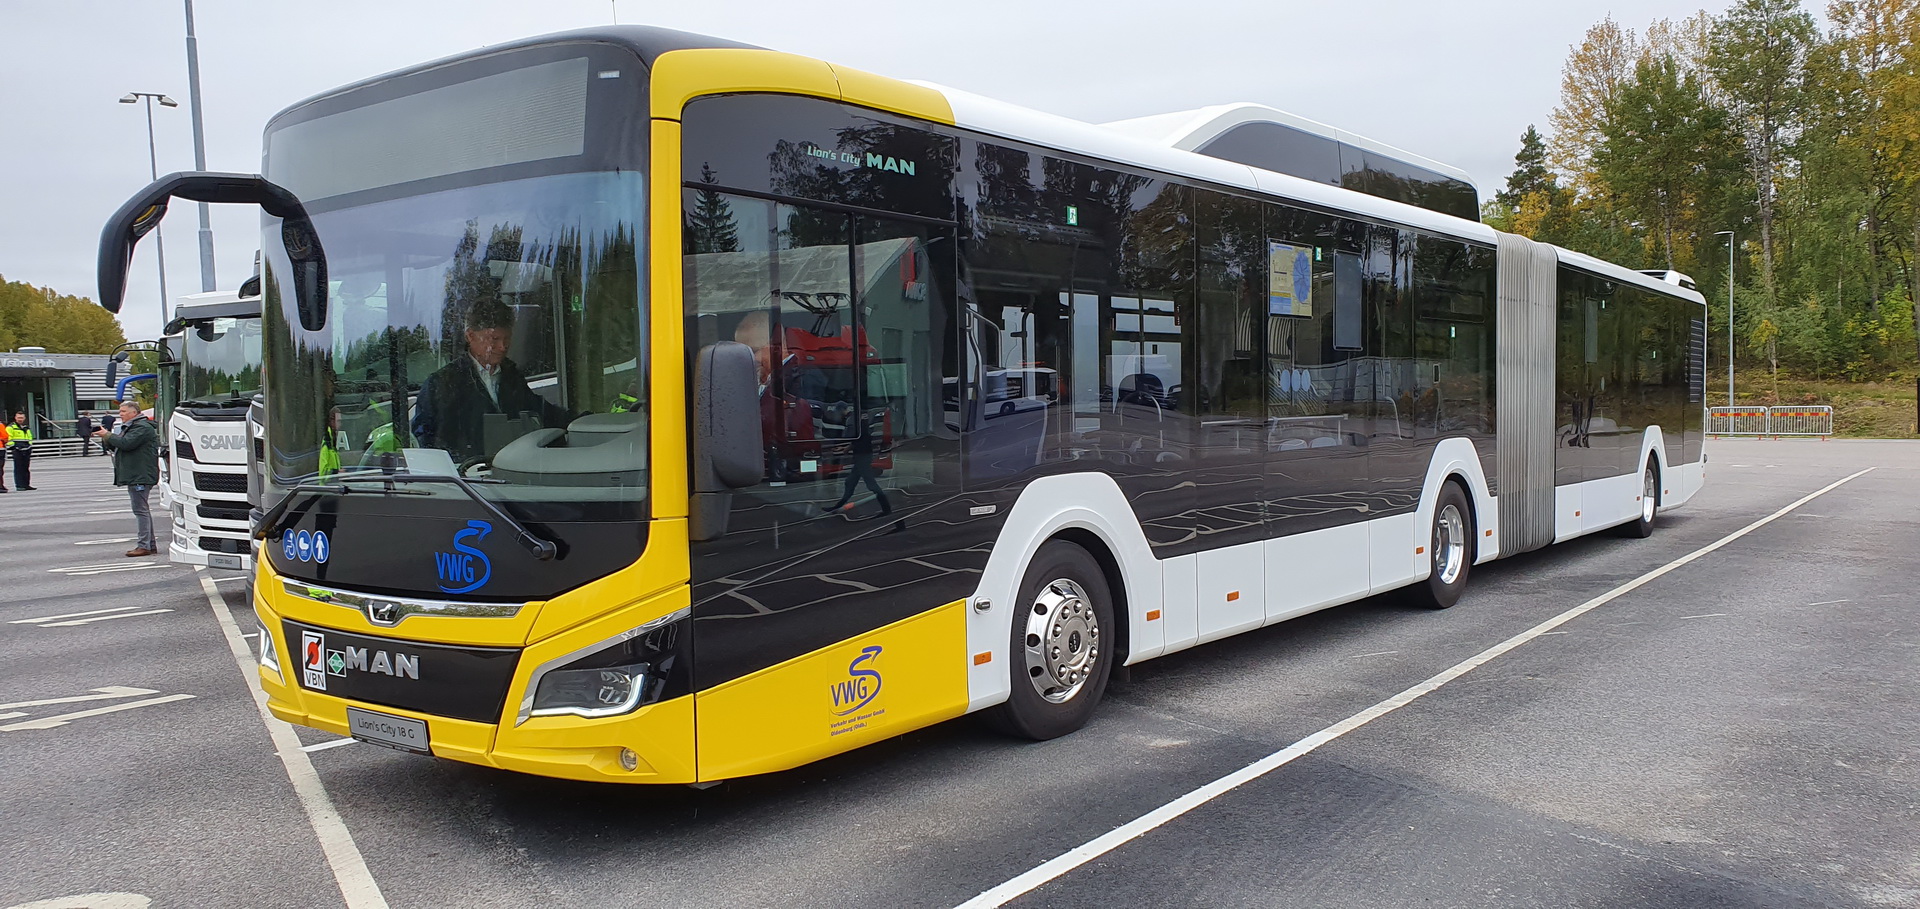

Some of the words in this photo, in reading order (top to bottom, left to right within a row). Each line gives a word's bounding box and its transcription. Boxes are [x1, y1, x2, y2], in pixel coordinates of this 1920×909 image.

[807, 145, 837, 160] Lion's
[841, 152, 861, 167] City
[866, 152, 916, 176] MAN
[201, 434, 248, 450] SCANIA
[434, 551, 475, 583] VWG
[345, 645, 420, 680] MAN
[305, 672, 324, 687] VBN
[831, 677, 867, 706] VWG
[357, 718, 380, 732] Lion's
[381, 724, 396, 737] City
[397, 725, 406, 736] 18
[408, 728, 415, 738] G
